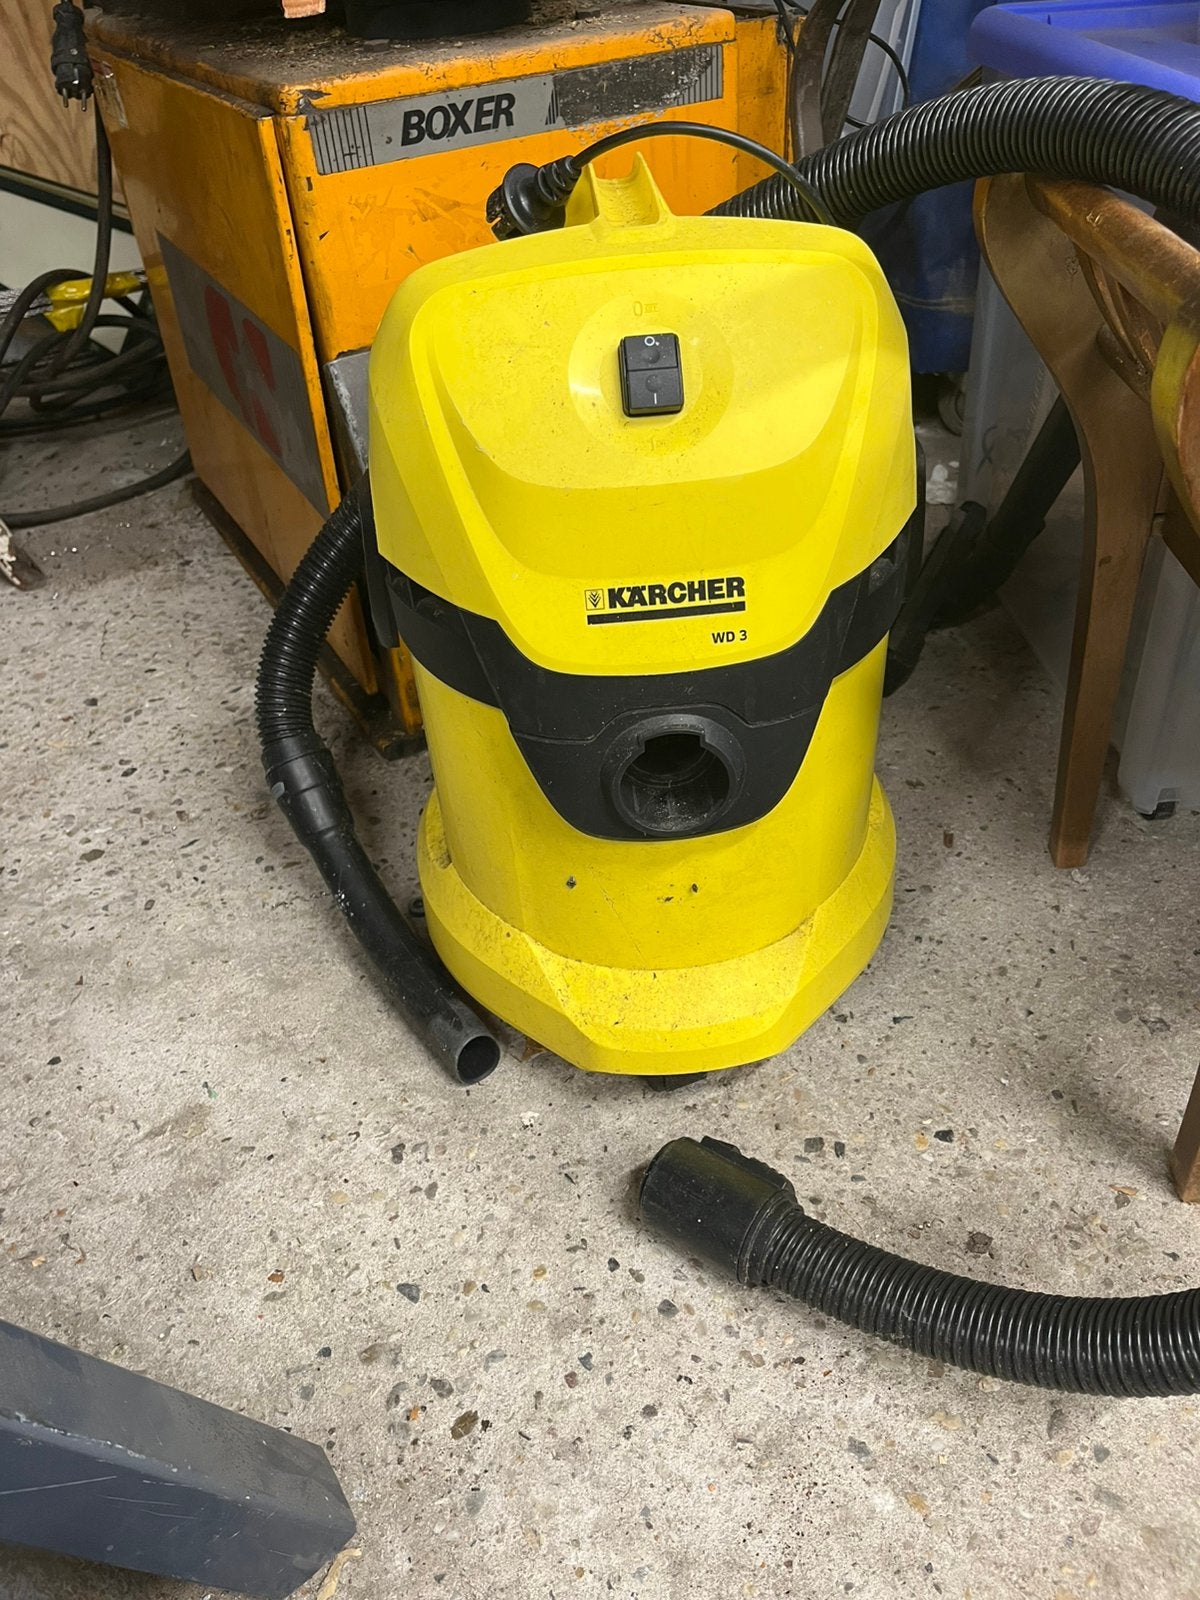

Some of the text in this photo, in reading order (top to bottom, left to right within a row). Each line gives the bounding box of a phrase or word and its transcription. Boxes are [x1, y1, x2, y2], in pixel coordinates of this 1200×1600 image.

[401, 93, 515, 146] BOXER
[608, 576, 745, 609] KÄRCHER
[711, 630, 747, 643] WD 3
